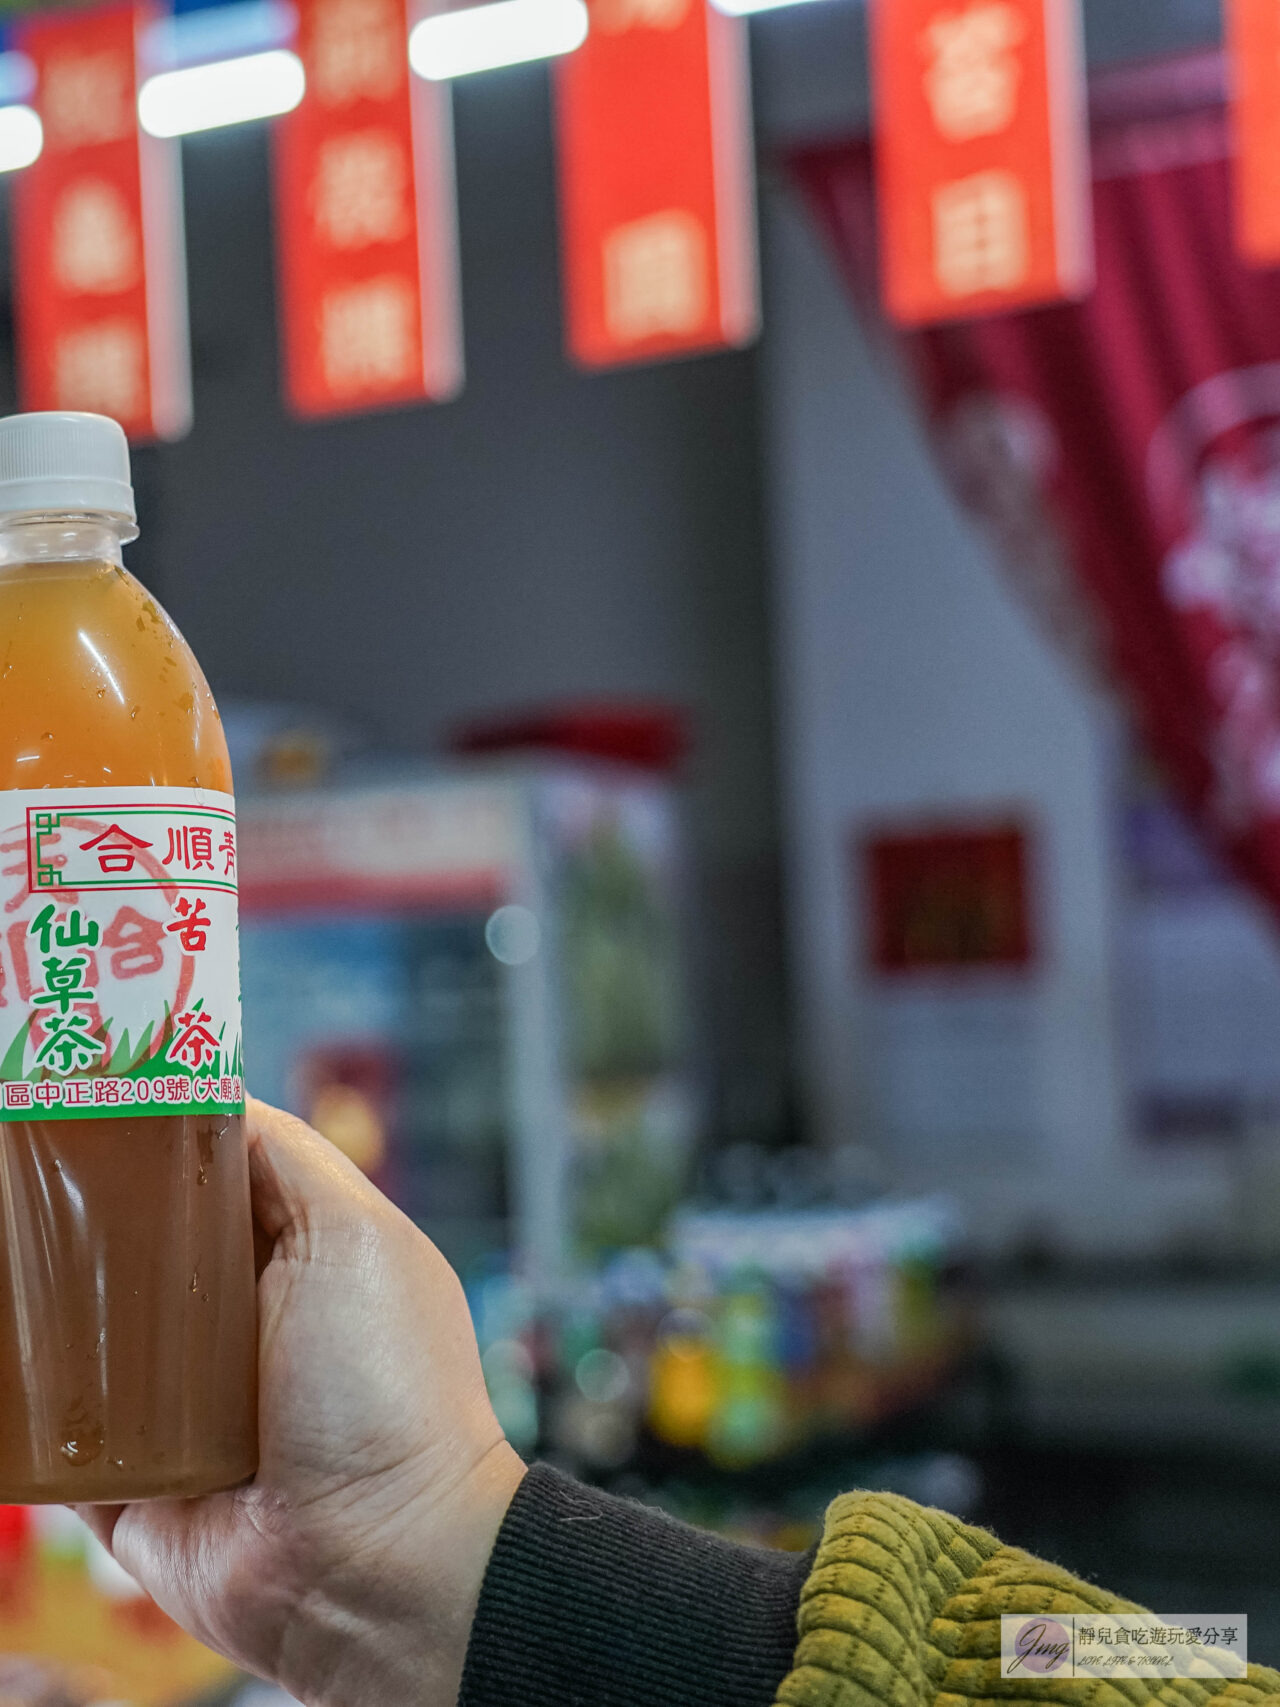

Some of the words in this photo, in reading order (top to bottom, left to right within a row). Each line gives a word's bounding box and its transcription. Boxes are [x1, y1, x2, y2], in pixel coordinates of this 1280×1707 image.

[30, 903, 104, 1070] 仙草茶
[167, 897, 220, 1068] 苦茶
